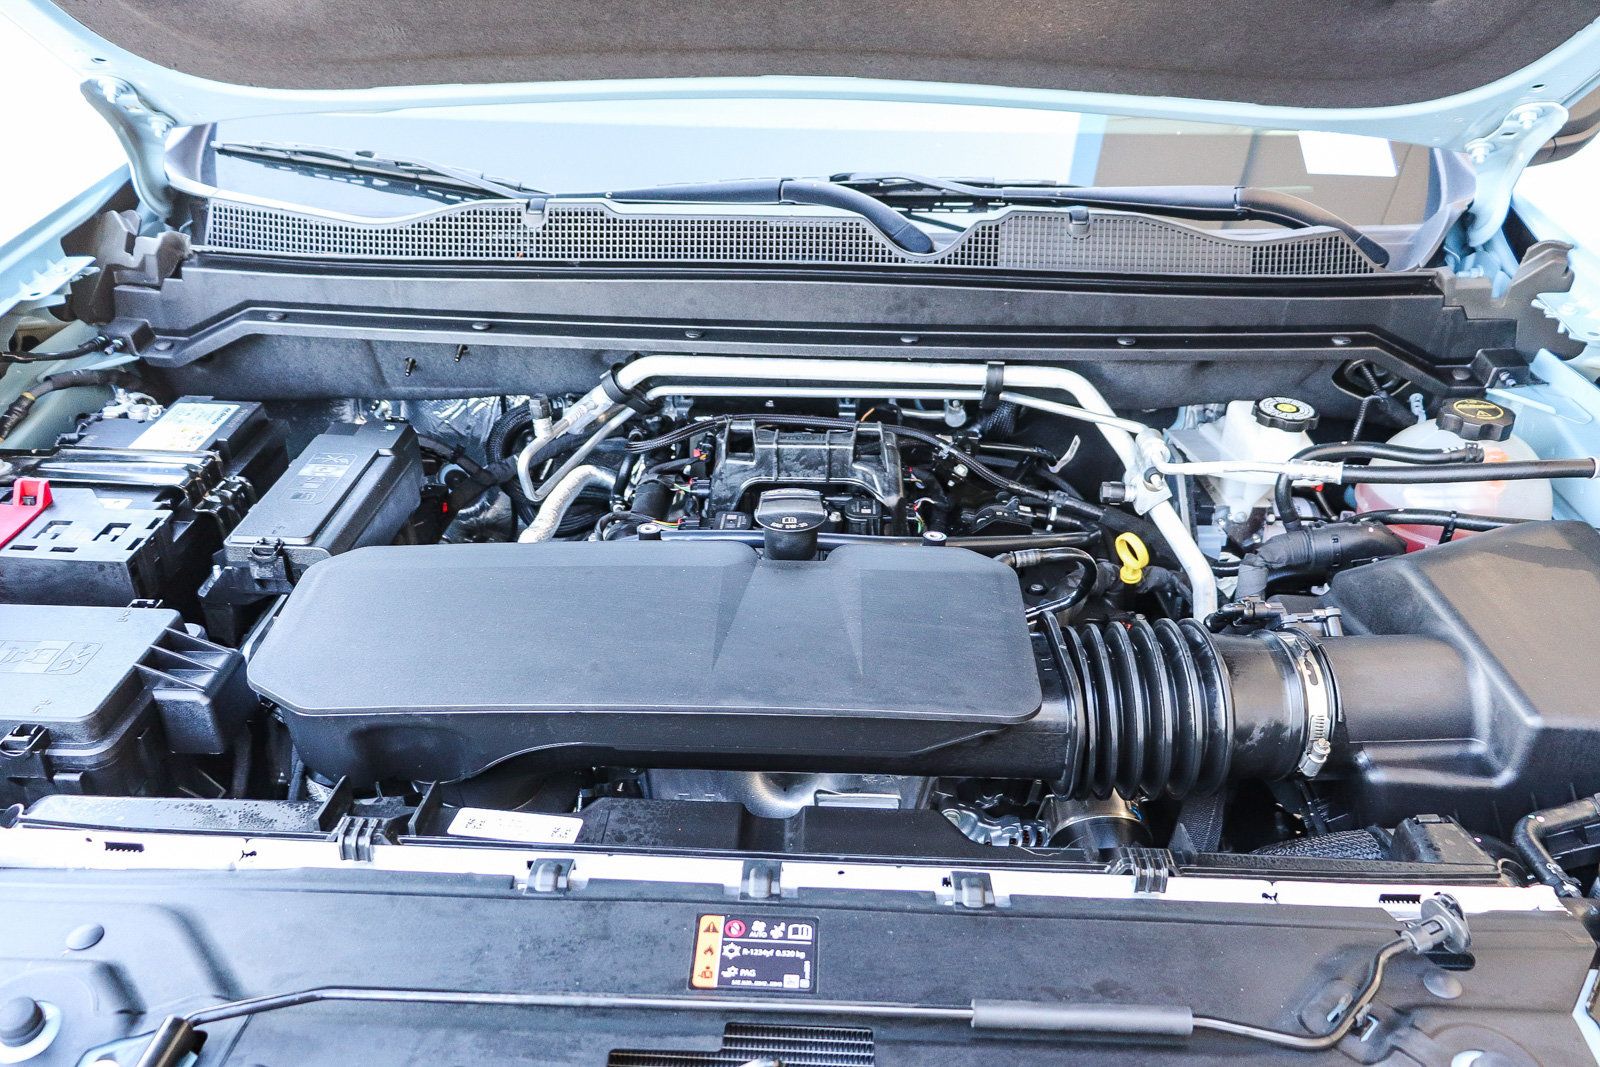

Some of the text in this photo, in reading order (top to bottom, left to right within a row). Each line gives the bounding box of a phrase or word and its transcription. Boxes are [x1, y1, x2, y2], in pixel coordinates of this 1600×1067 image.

[742, 948, 774, 957] R-1234yf
[796, 951, 805, 959] kg
[740, 969, 756, 977] PAG
